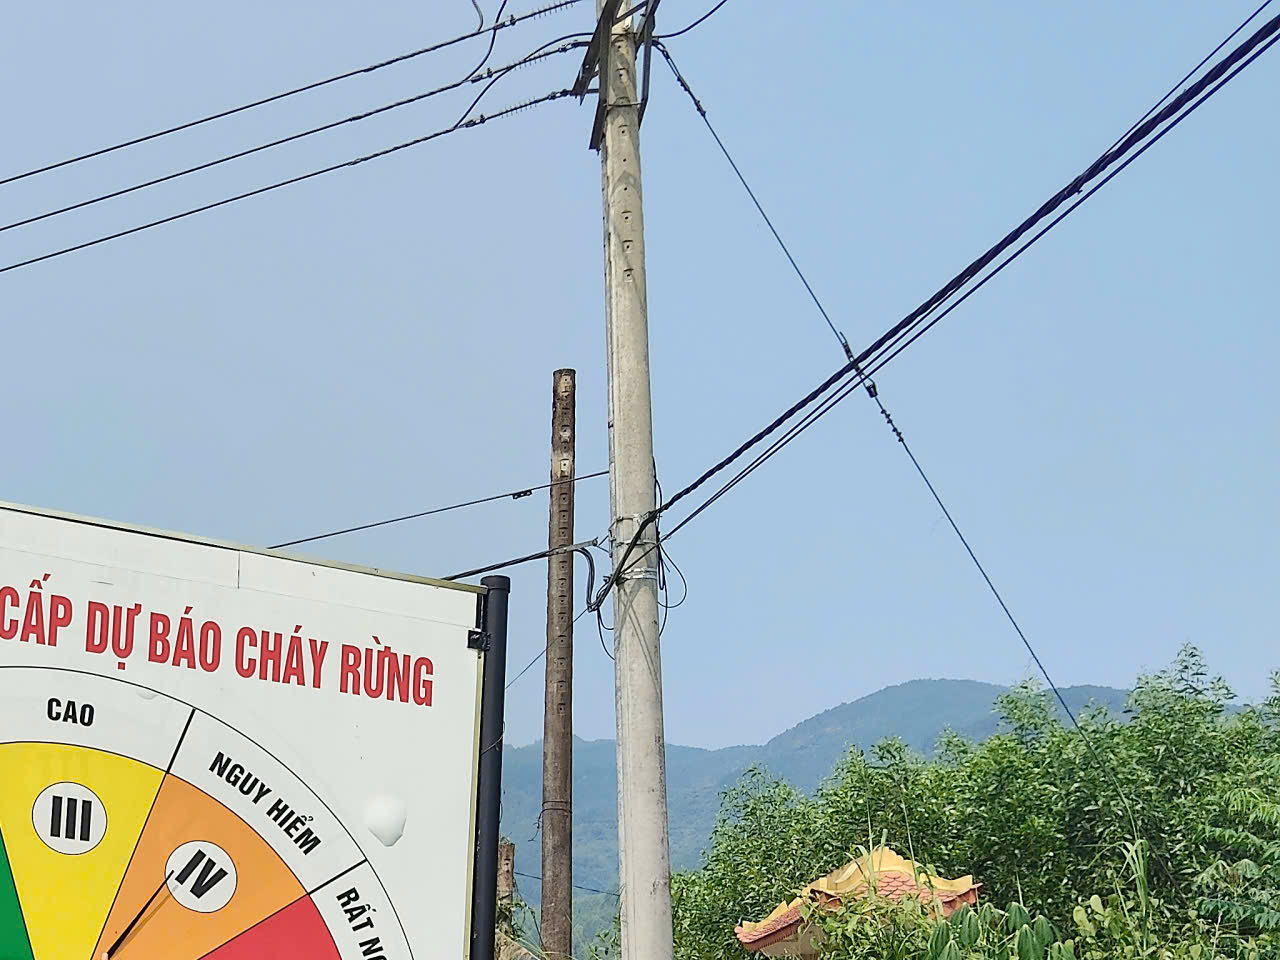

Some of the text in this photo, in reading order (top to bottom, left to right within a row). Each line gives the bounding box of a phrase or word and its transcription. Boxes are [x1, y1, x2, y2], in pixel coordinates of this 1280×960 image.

[85, 601, 142, 671] DỰ
[148, 606, 222, 673] BÁO
[234, 625, 329, 689] CHÁY
[339, 635, 434, 707] RỪNG
[47, 697, 95, 727] CAO
[50, 796, 93, 842] III
[208, 751, 321, 856] NGUY HIỂM
[174, 849, 229, 899] IV
[336, 887, 377, 932] RẤT
